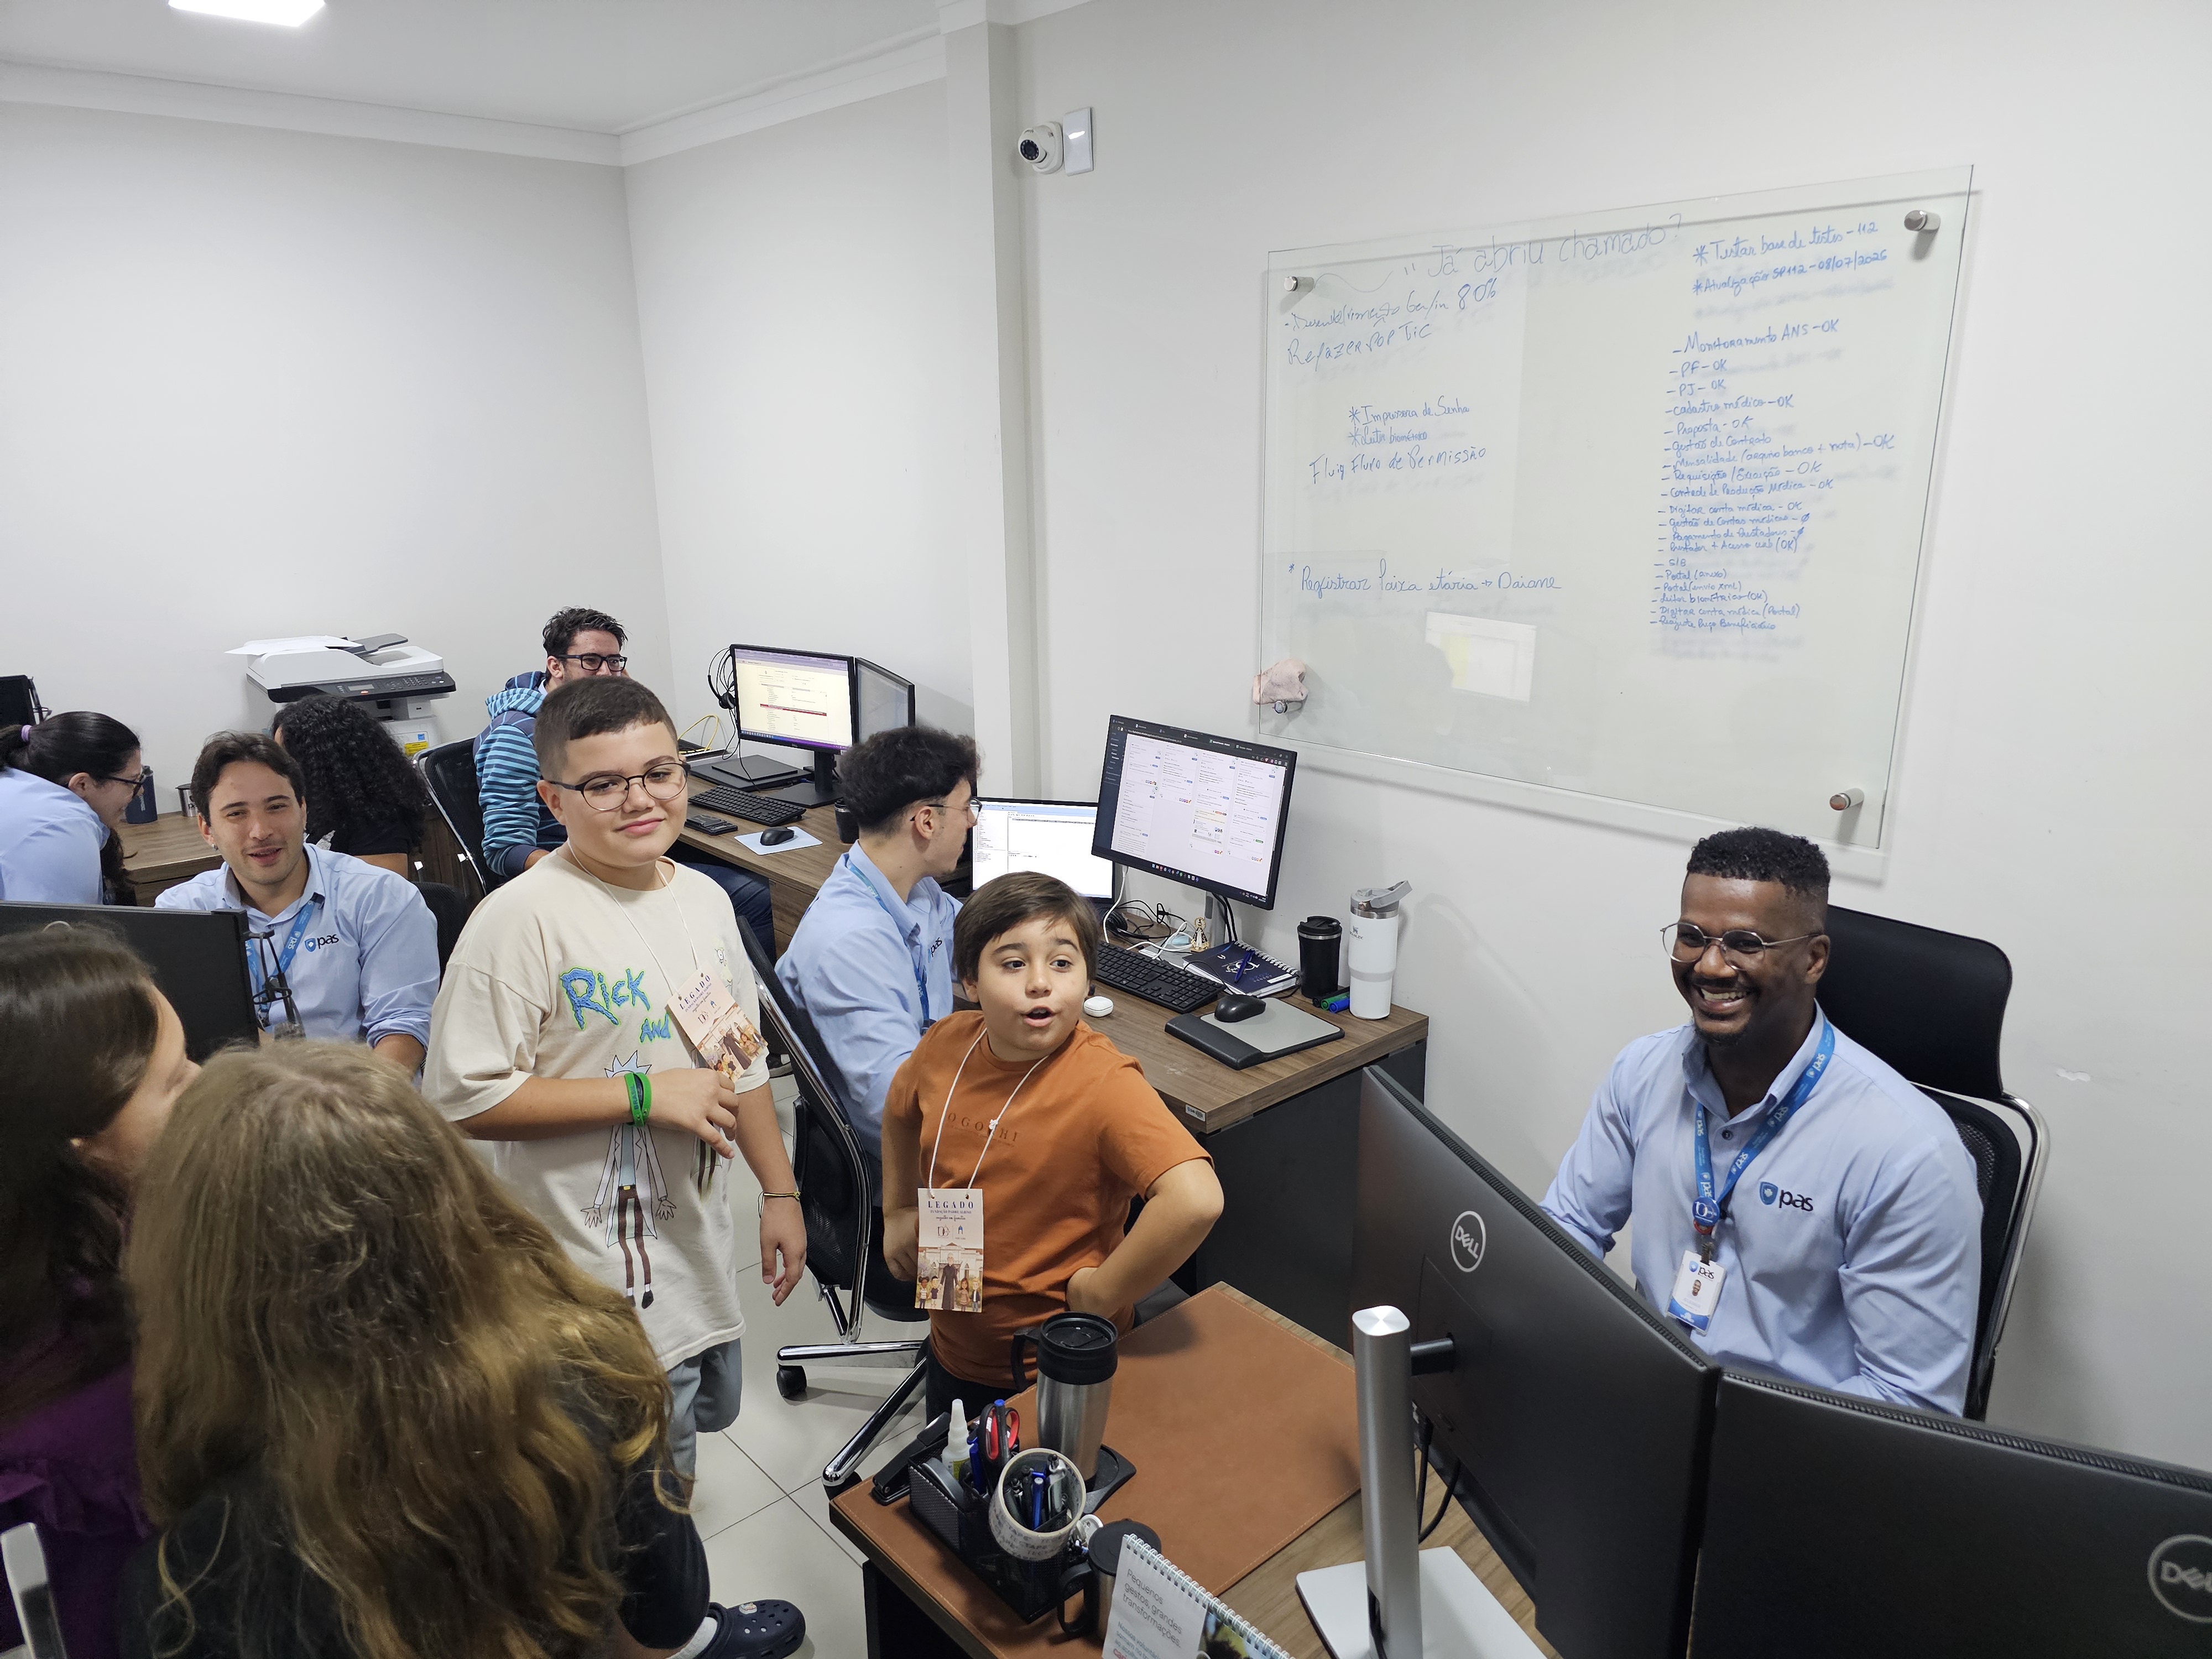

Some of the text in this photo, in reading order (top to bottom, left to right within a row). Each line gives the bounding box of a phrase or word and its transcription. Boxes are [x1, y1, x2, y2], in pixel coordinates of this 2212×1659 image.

[1475, 236, 1545, 273] abriu
[1782, 324, 1809, 340] ANS
[1423, 402, 1433, 416] de
[1389, 452, 1404, 470] de
[1429, 568, 1478, 592] etária
[1498, 571, 1562, 590] Daiane
[317, 933, 340, 950] pas
[930, 937, 942, 957] pas
[680, 975, 711, 1010] LEGADO
[630, 1085, 639, 1110] BRASIL
[948, 1112, 1018, 1142] OGOHI
[928, 1201, 973, 1209] LEGADO
[1779, 1190, 1814, 1212] pas
[1455, 1225, 1479, 1259] DELL
[1698, 1266, 1714, 1280] pas
[1126, 1568, 1163, 1604] Pequenos
[1123, 1593, 1181, 1648] transformações.
[1124, 1583, 1183, 1634] gestos, grandes
